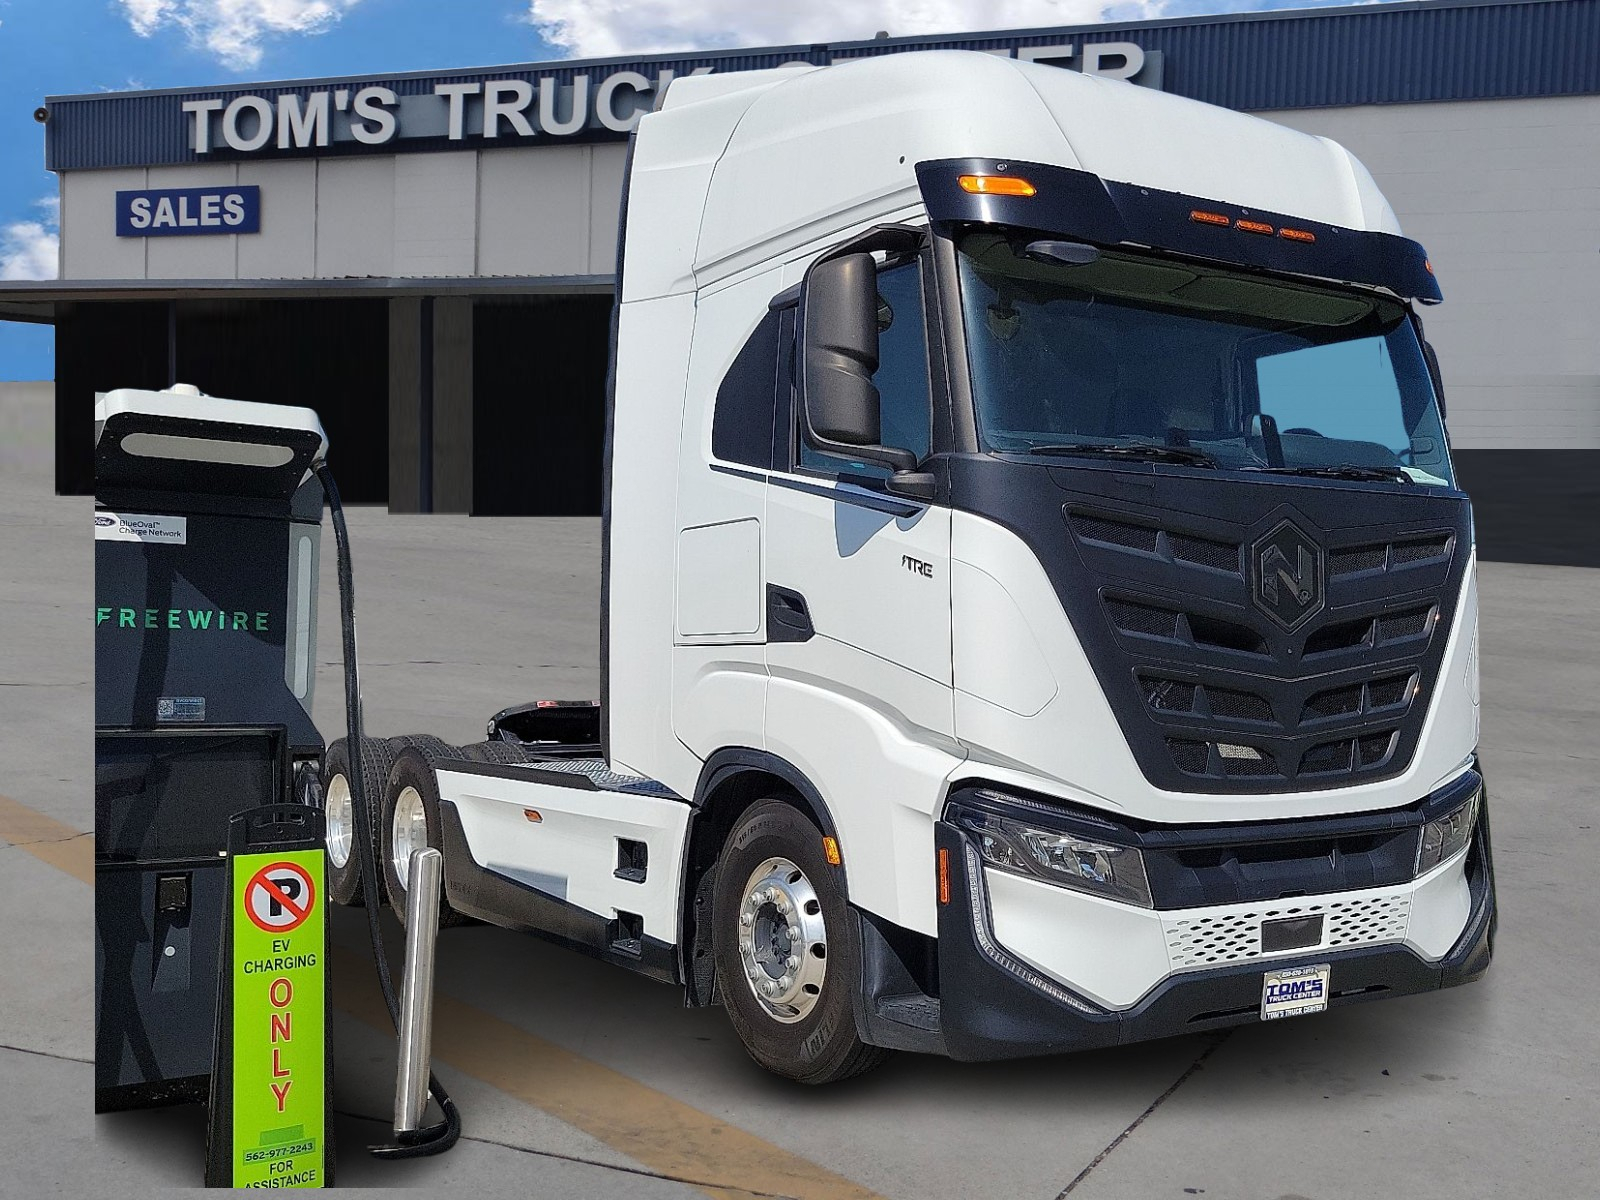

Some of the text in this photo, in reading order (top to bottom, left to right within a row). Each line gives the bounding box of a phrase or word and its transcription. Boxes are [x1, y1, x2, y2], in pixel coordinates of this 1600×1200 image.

[182, 87, 397, 154] TOM'S
[129, 193, 245, 229] SALES
[119, 527, 182, 538] Charge Network
[272, 939, 290, 953] EV
[244, 954, 316, 973] CHARGING
[1267, 979, 1322, 996] TOM'S
[1268, 991, 1321, 1003] TRUCK CENTER
[1285, 1007, 1303, 1017] TRUCK
[269, 977, 293, 1112] ONLY
[245, 1142, 313, 1162] 562-977-2243
[269, 1159, 293, 1175] FOR
